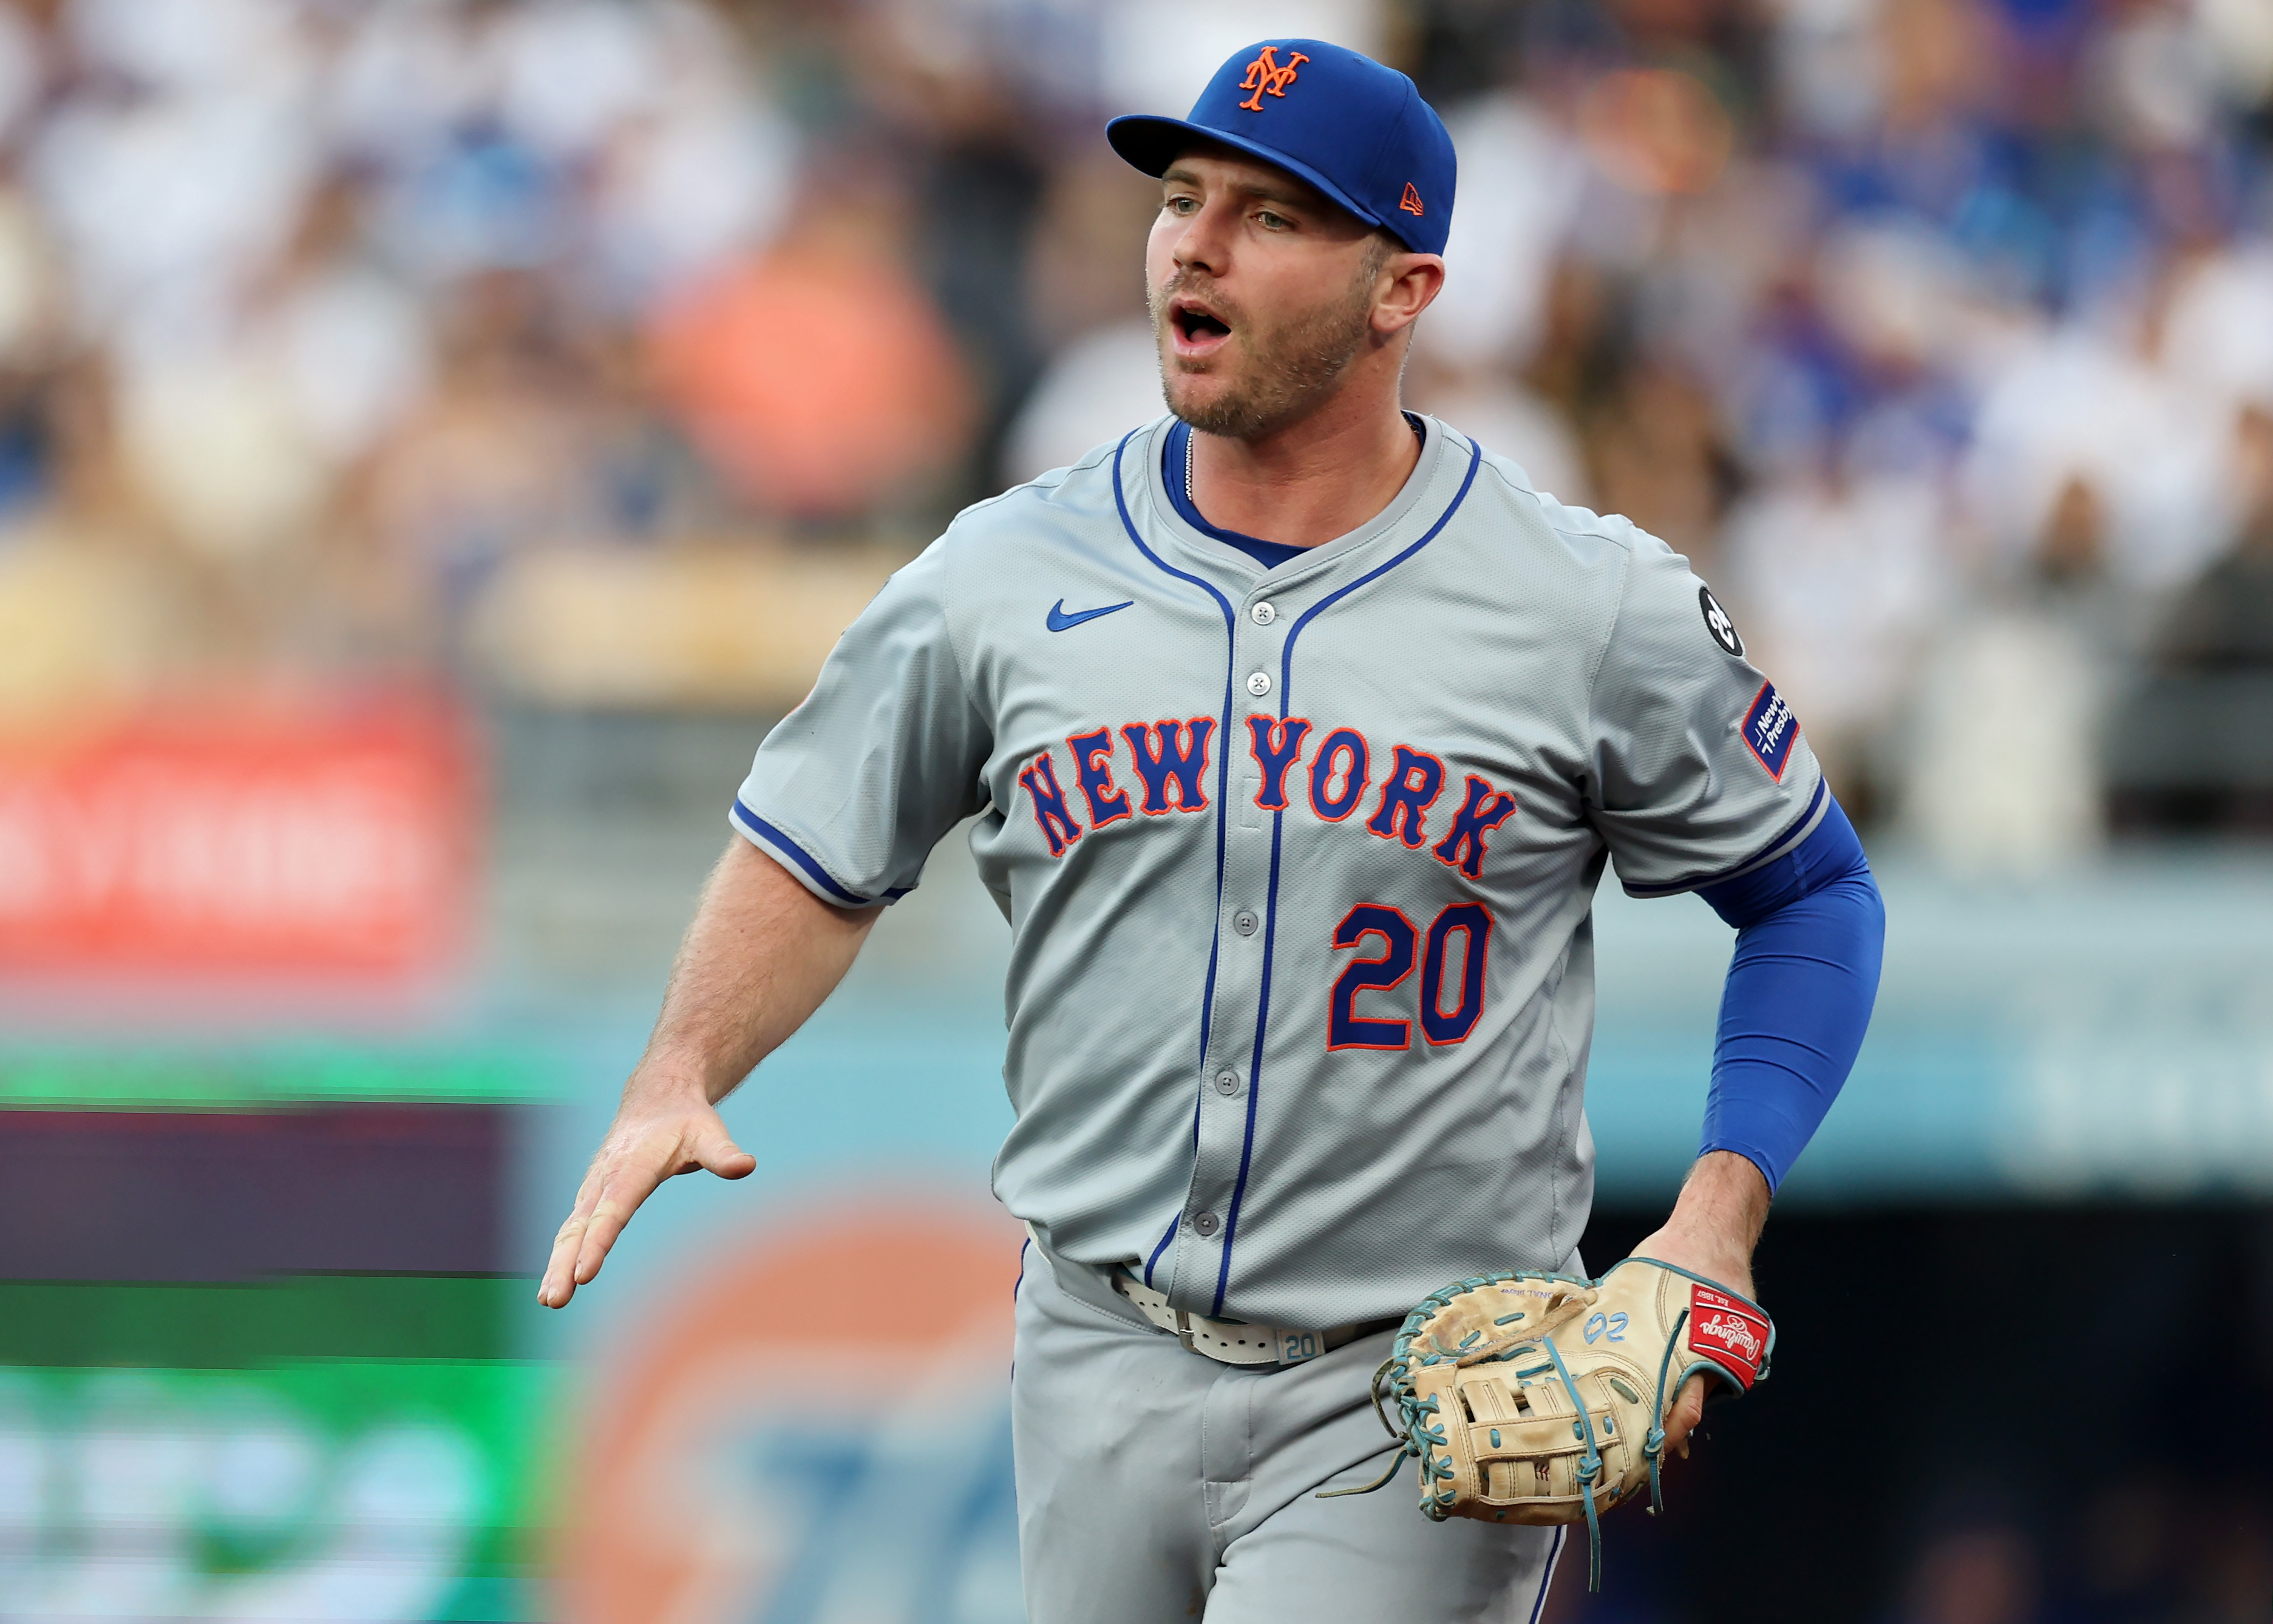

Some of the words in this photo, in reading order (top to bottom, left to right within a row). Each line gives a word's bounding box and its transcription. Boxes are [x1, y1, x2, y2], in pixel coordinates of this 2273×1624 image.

[1238, 46, 1310, 112] NY
[1019, 715, 1217, 858] NEW
[1245, 714, 1517, 880] YORK
[1327, 902, 1495, 1052] 20
[1697, 1290, 1714, 1302] 1887
[1286, 1333, 1316, 1359] 20
[1583, 1312, 1629, 1345] 20
[1699, 1314, 1761, 1361] Rawlings
